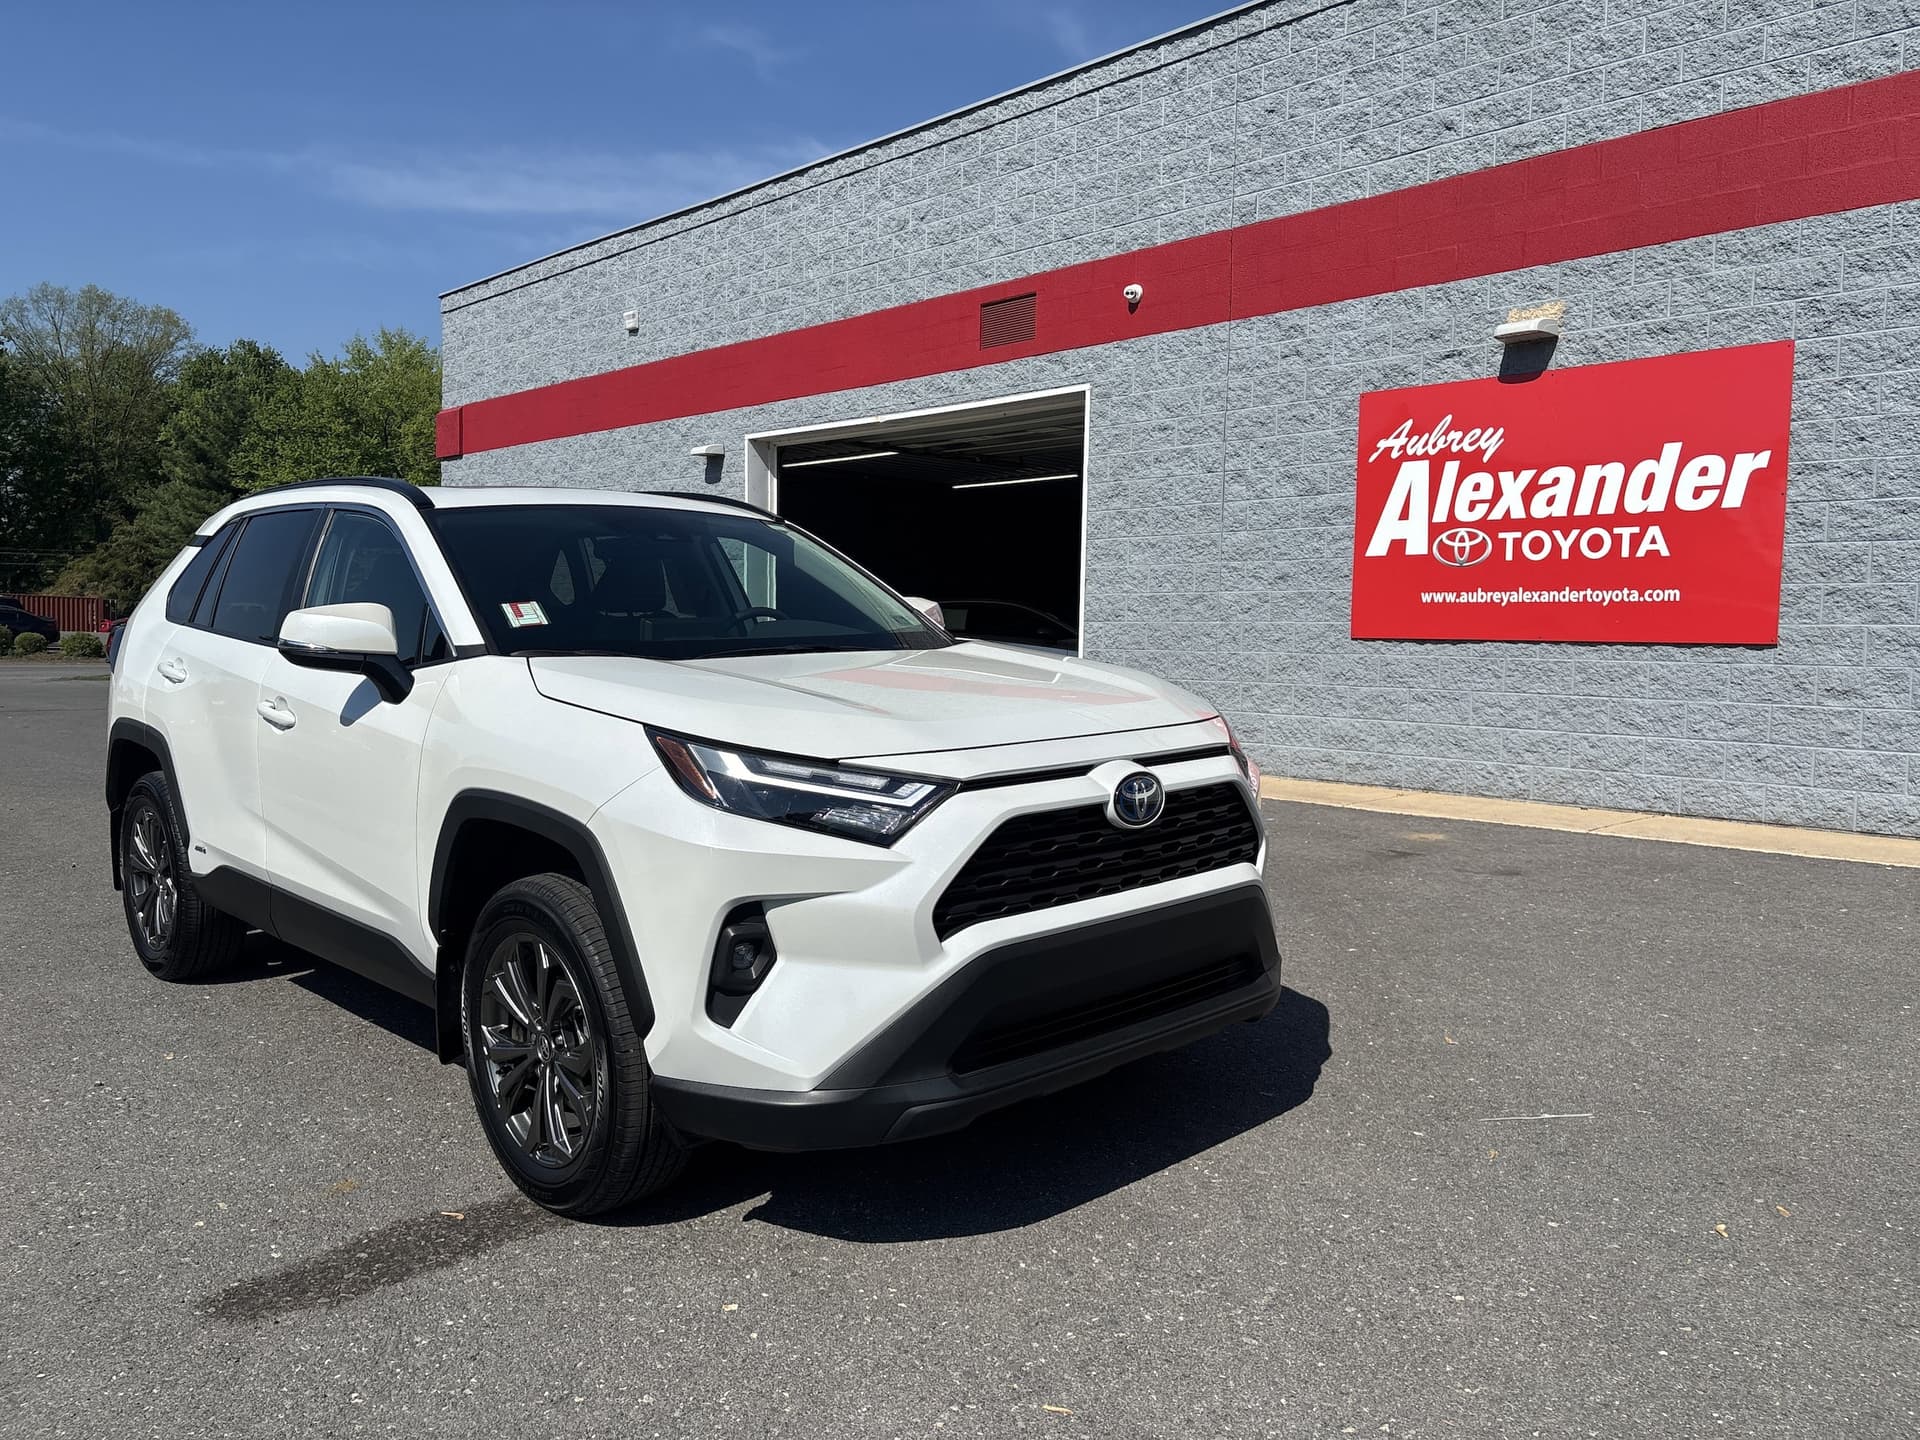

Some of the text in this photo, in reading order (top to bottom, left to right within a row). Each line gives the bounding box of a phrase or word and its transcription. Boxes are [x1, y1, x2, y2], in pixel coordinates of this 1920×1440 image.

[1368, 414, 1505, 463] Aubrey
[1365, 441, 1772, 557] Alexander
[1498, 525, 1670, 561] TOYOTA
[1421, 586, 1681, 607] www.aubreyalexandertoyota.com
